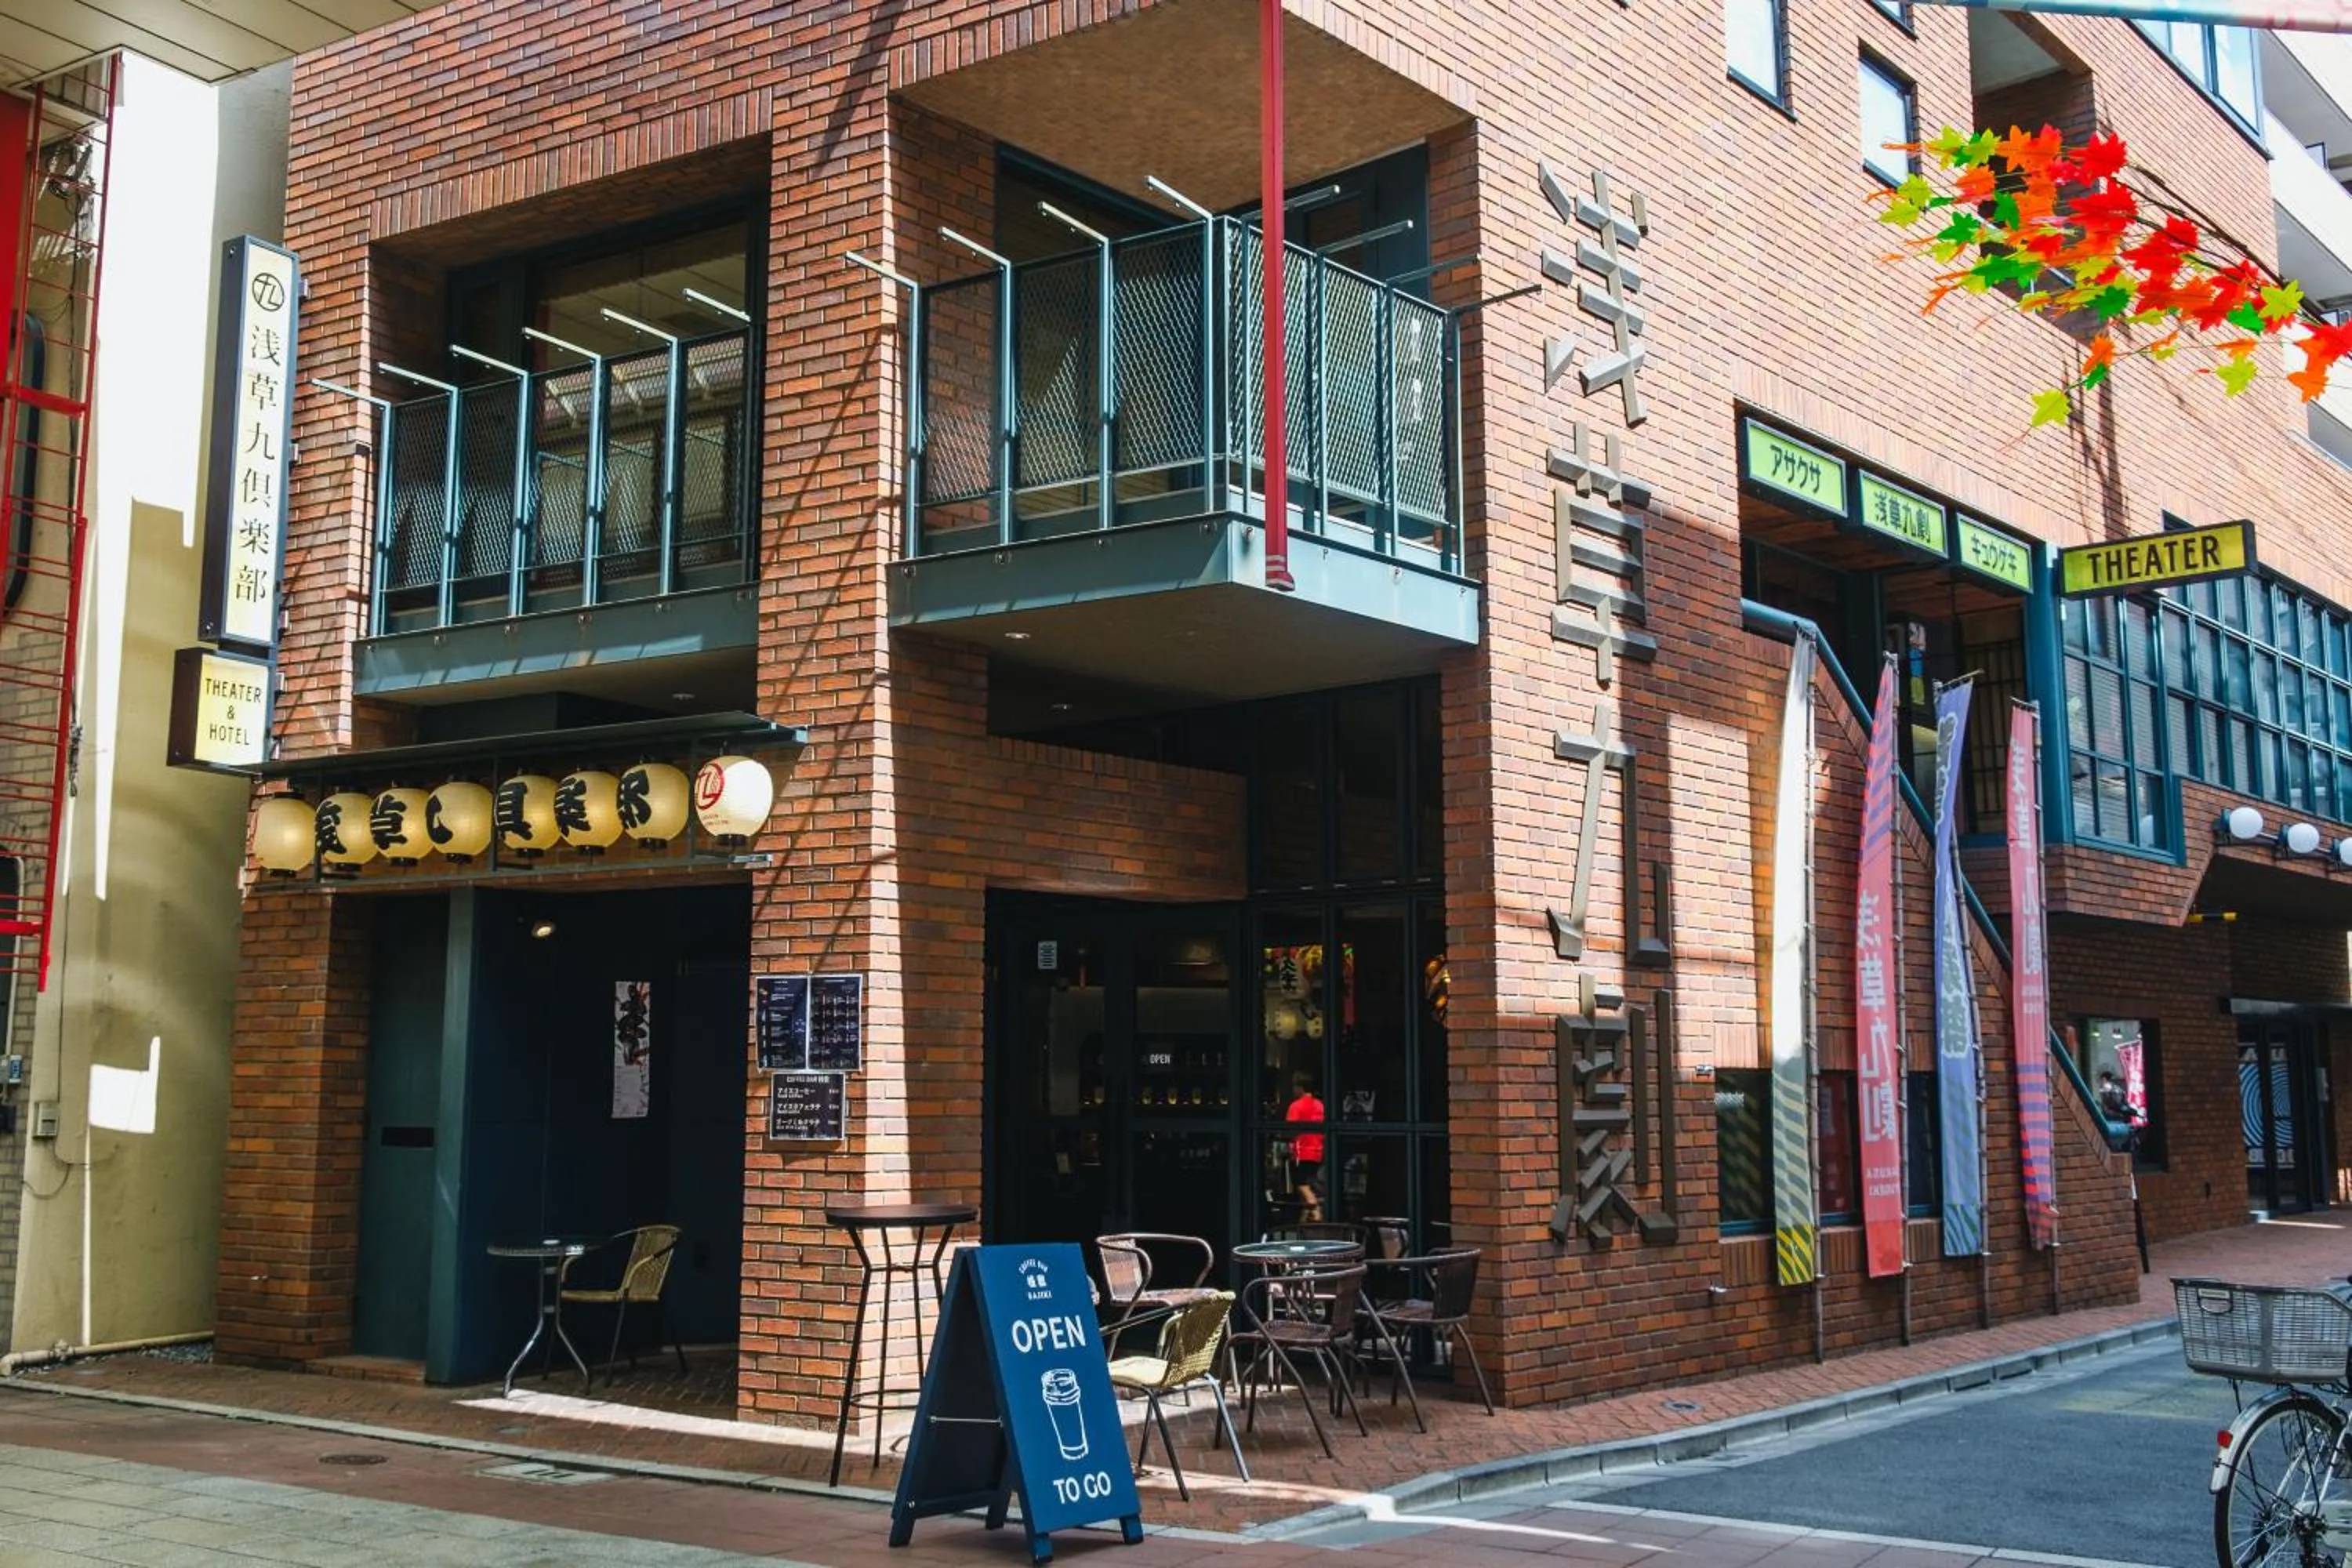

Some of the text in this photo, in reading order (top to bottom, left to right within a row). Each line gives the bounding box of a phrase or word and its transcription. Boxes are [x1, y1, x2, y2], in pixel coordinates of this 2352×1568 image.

[235, 325, 281, 603] 浅草九倶楽部
[1769, 442, 1821, 495] アサクサ
[1874, 489, 1932, 546] 浅草九劇
[1970, 533, 2018, 578] キュウゲキ
[2087, 535, 2222, 585] THEATER
[205, 677, 262, 704] THEATER
[209, 722, 250, 747] HOTEL
[227, 710, 235, 720] &
[1149, 1053, 1171, 1065] OPEN
[1011, 1314, 1087, 1353] OPEN
[1053, 1471, 1112, 1504] TO GO
